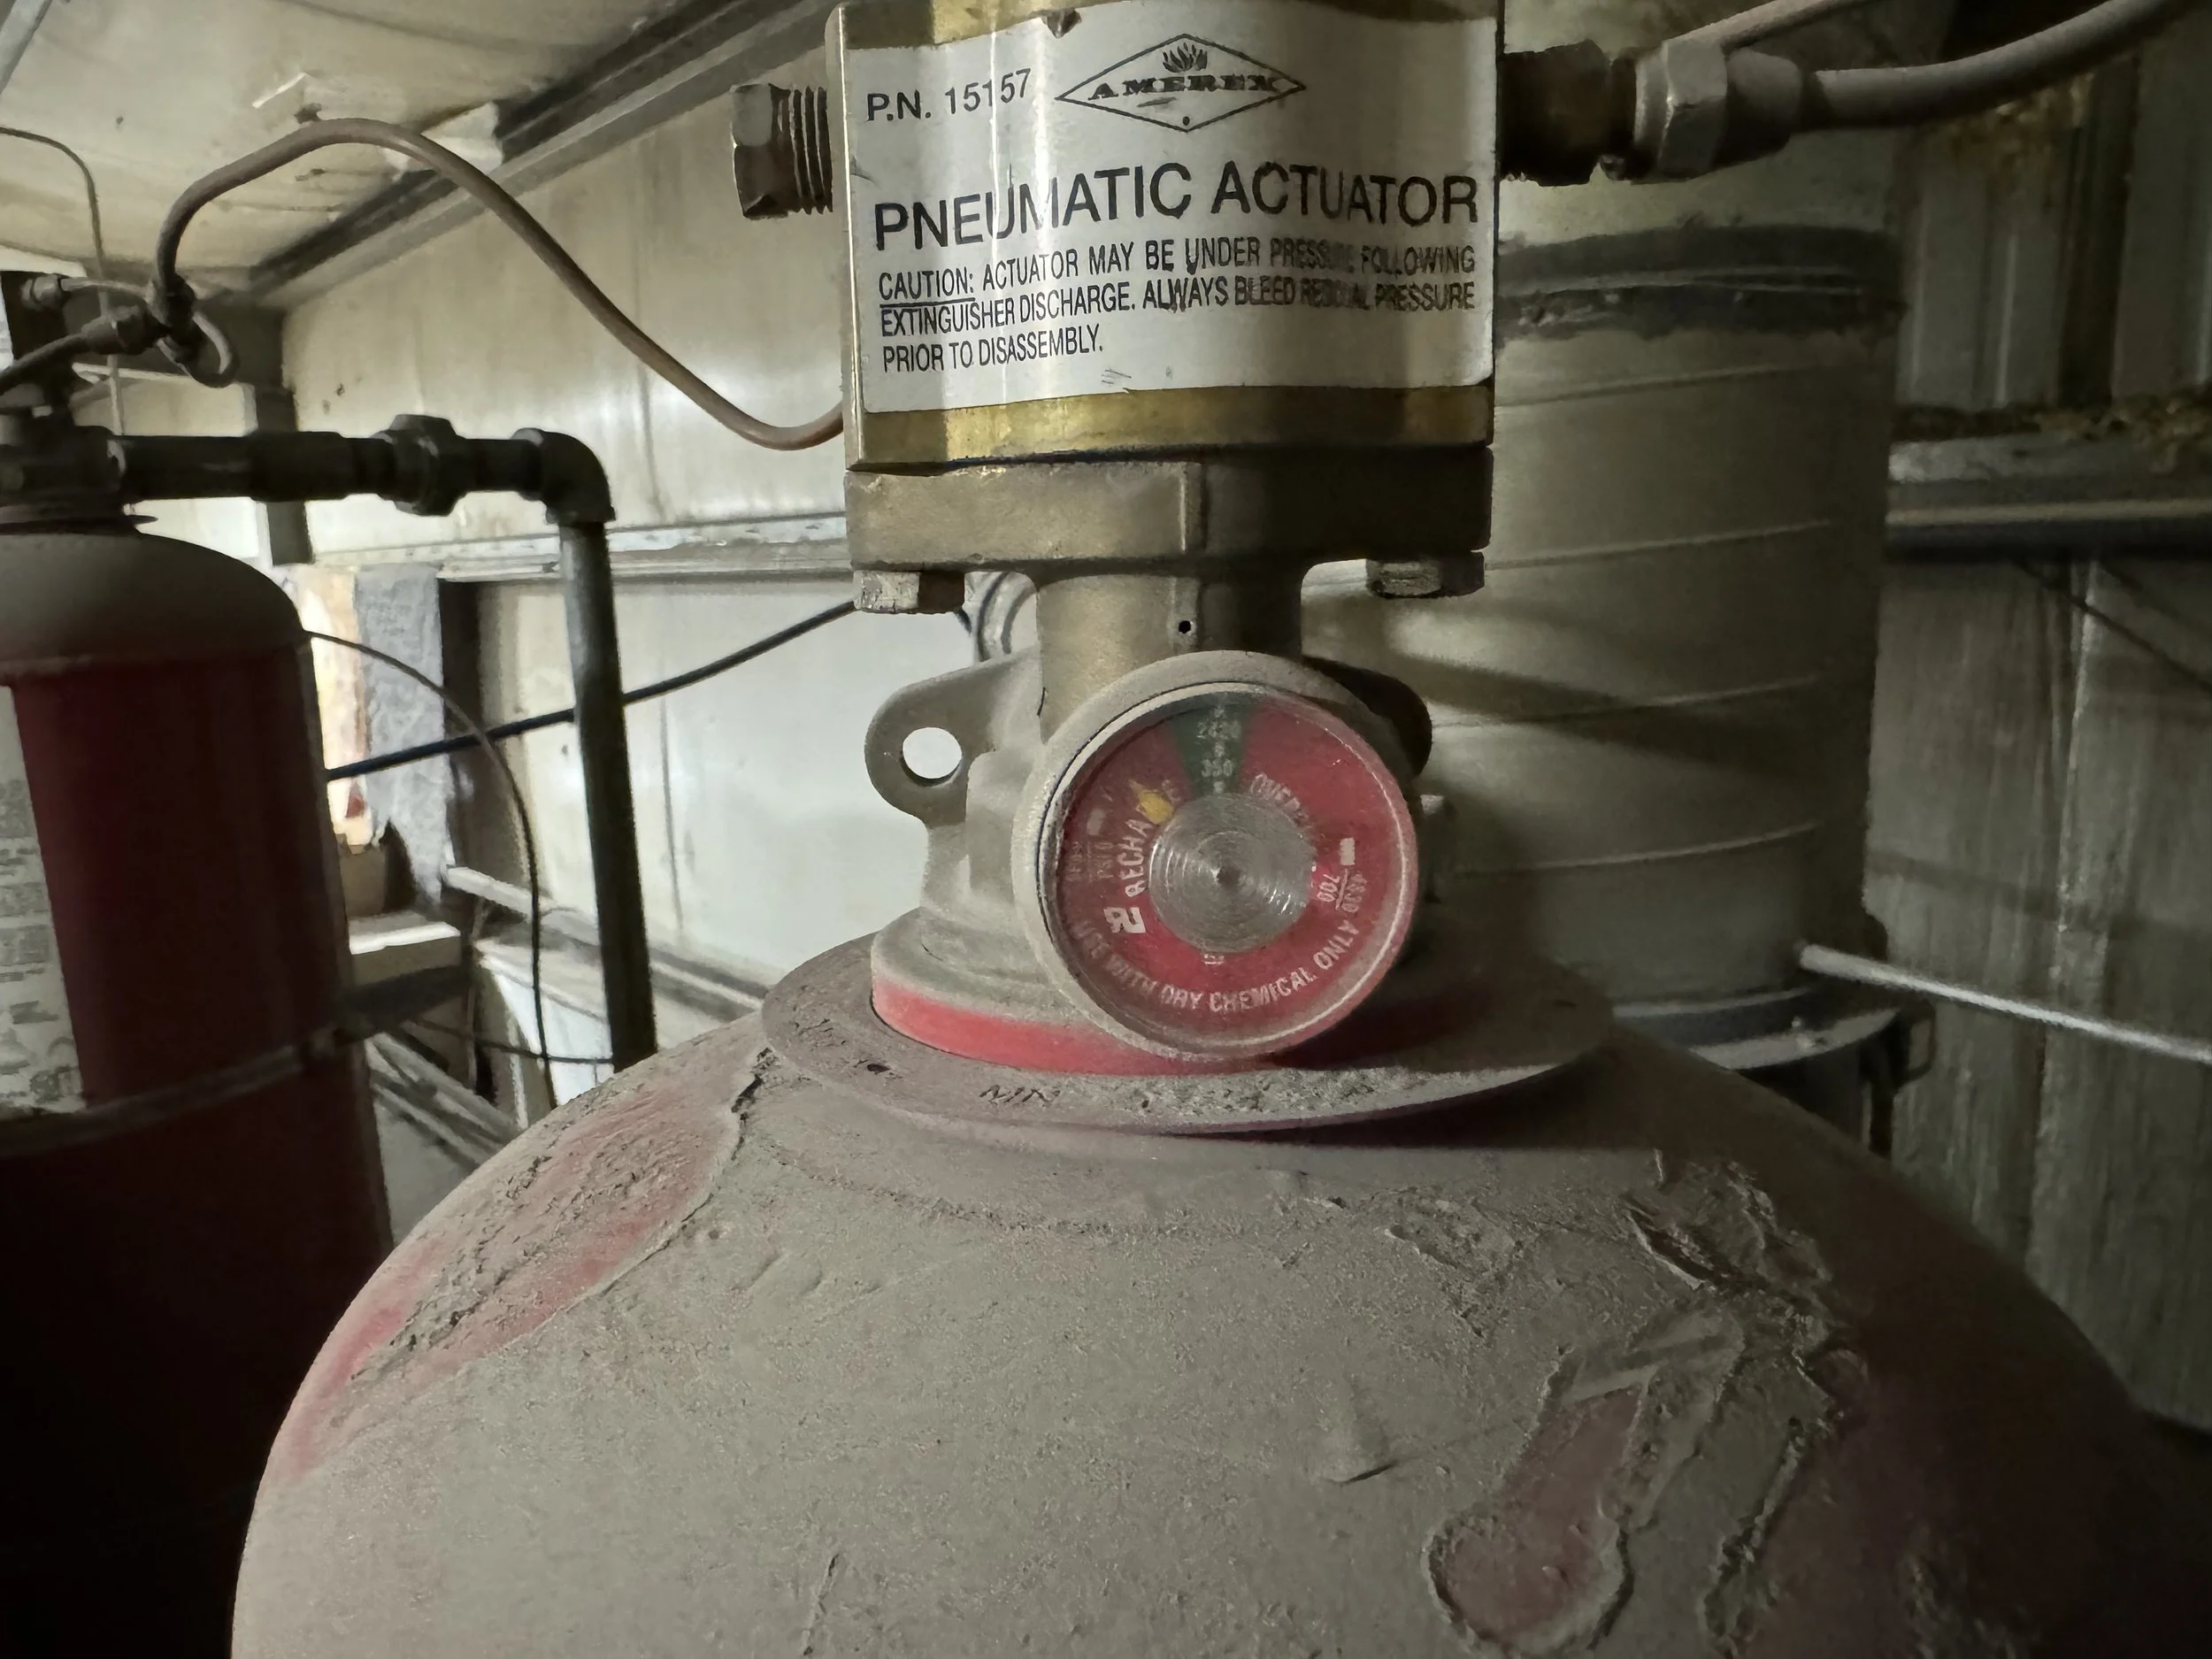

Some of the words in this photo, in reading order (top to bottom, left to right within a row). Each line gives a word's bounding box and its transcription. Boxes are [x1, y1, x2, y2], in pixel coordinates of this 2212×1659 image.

[867, 90, 931, 121] P.N.
[945, 68, 1032, 115] 15157
[1087, 74, 1282, 101] AMEREX
[874, 163, 1192, 251] PNEUMATIC
[1210, 160, 1479, 227] ACTUATOR
[879, 266, 974, 301] CAUTION:
[983, 249, 1079, 291] ACTUATOR
[1089, 241, 1134, 275] MAY
[1145, 239, 1174, 272] BE
[1185, 236, 1261, 275] UNDER
[1270, 236, 1355, 273] PRESS
[1362, 243, 1475, 275] FOLLOWING
[880, 297, 1017, 337] EXTINGUISHER
[1019, 280, 1135, 322] DISCHARGE.
[1142, 275, 1228, 312] ALWAYS
[1234, 275, 1295, 306] BLEED
[1374, 280, 1475, 311] PRESSURE
[883, 342, 945, 373] PRIOR
[949, 340, 972, 369] TO
[978, 322, 1103, 366] DISASSEMBLY.
[1117, 779, 1182, 898] RECHAE
[1317, 873, 1340, 903] 700
[1160, 984, 1204, 1010] DRY
[1209, 966, 1317, 1014] CHEMICAL
[1312, 918, 1360, 971] ONLY
